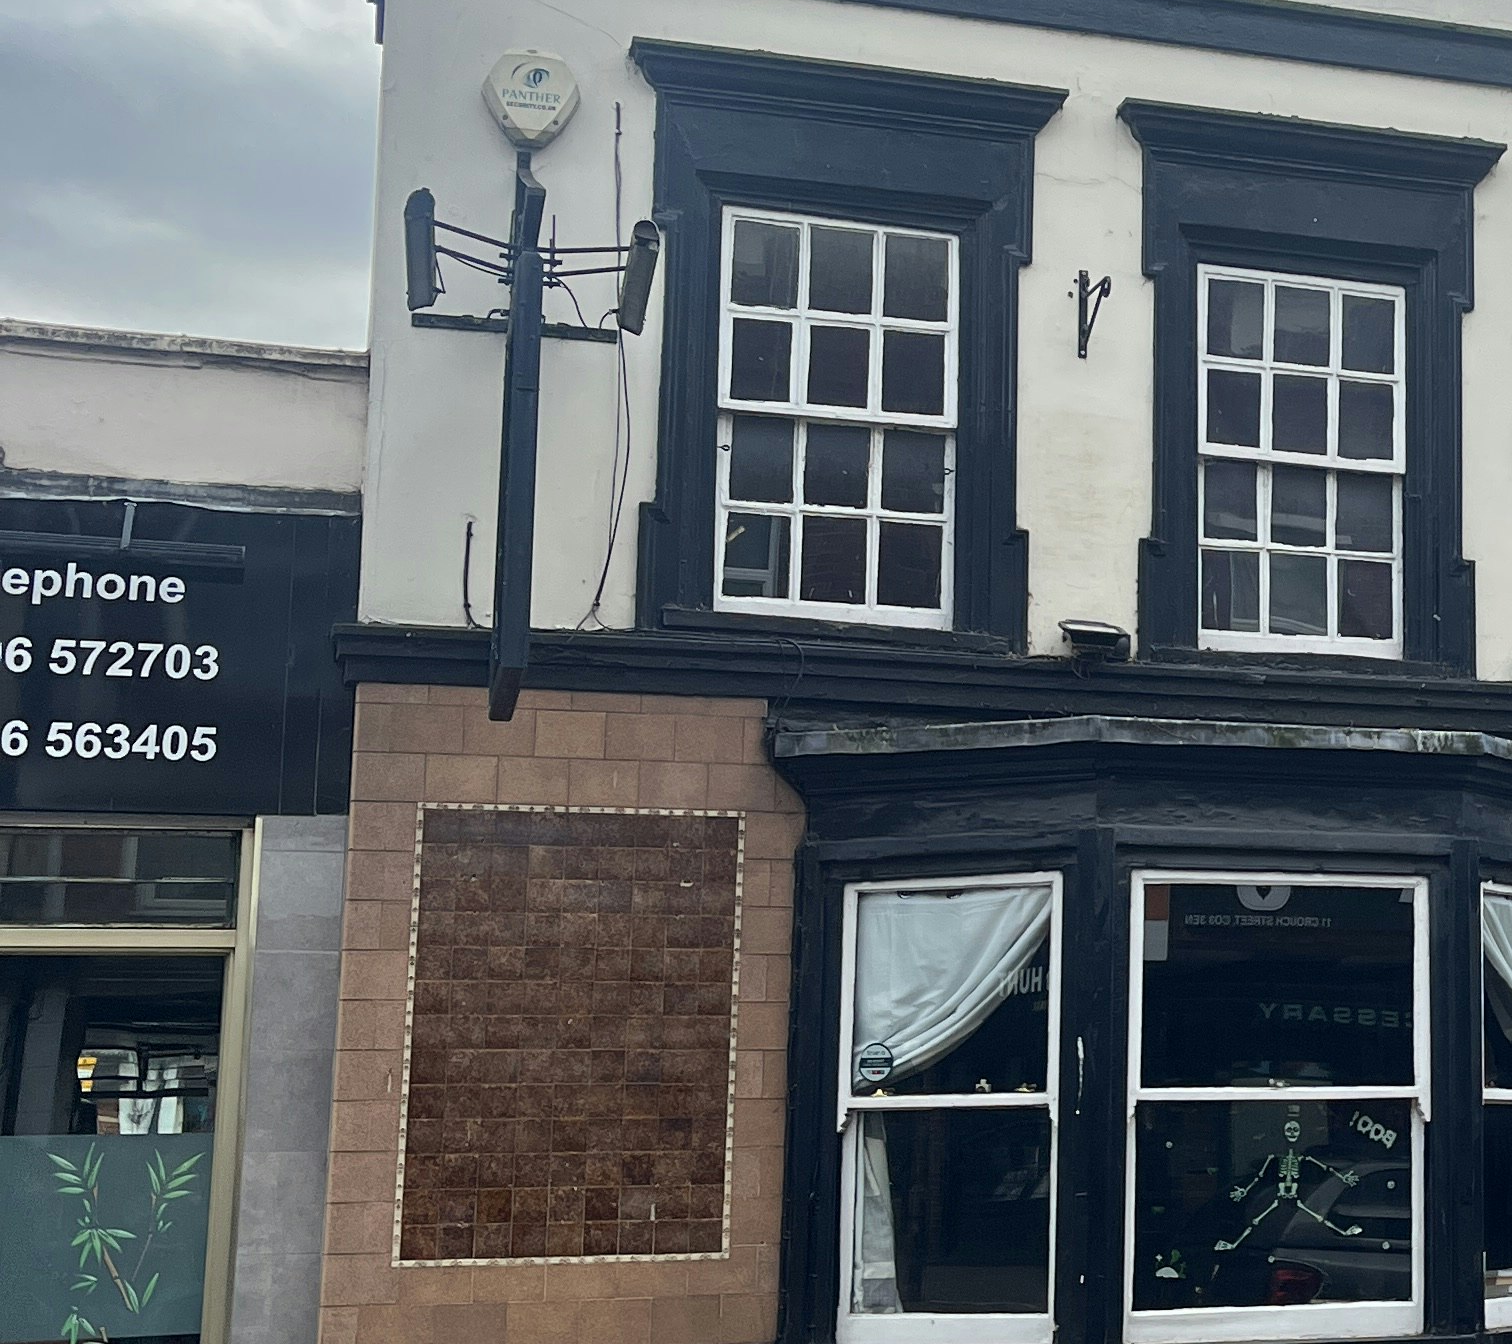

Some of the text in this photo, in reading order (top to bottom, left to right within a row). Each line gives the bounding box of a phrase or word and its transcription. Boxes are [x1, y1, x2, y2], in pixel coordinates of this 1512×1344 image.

[502, 88, 561, 104] PANTHER
[1, 562, 186, 605] ephone
[48, 638, 219, 681] 572703
[1, 719, 217, 762] 6 563405
